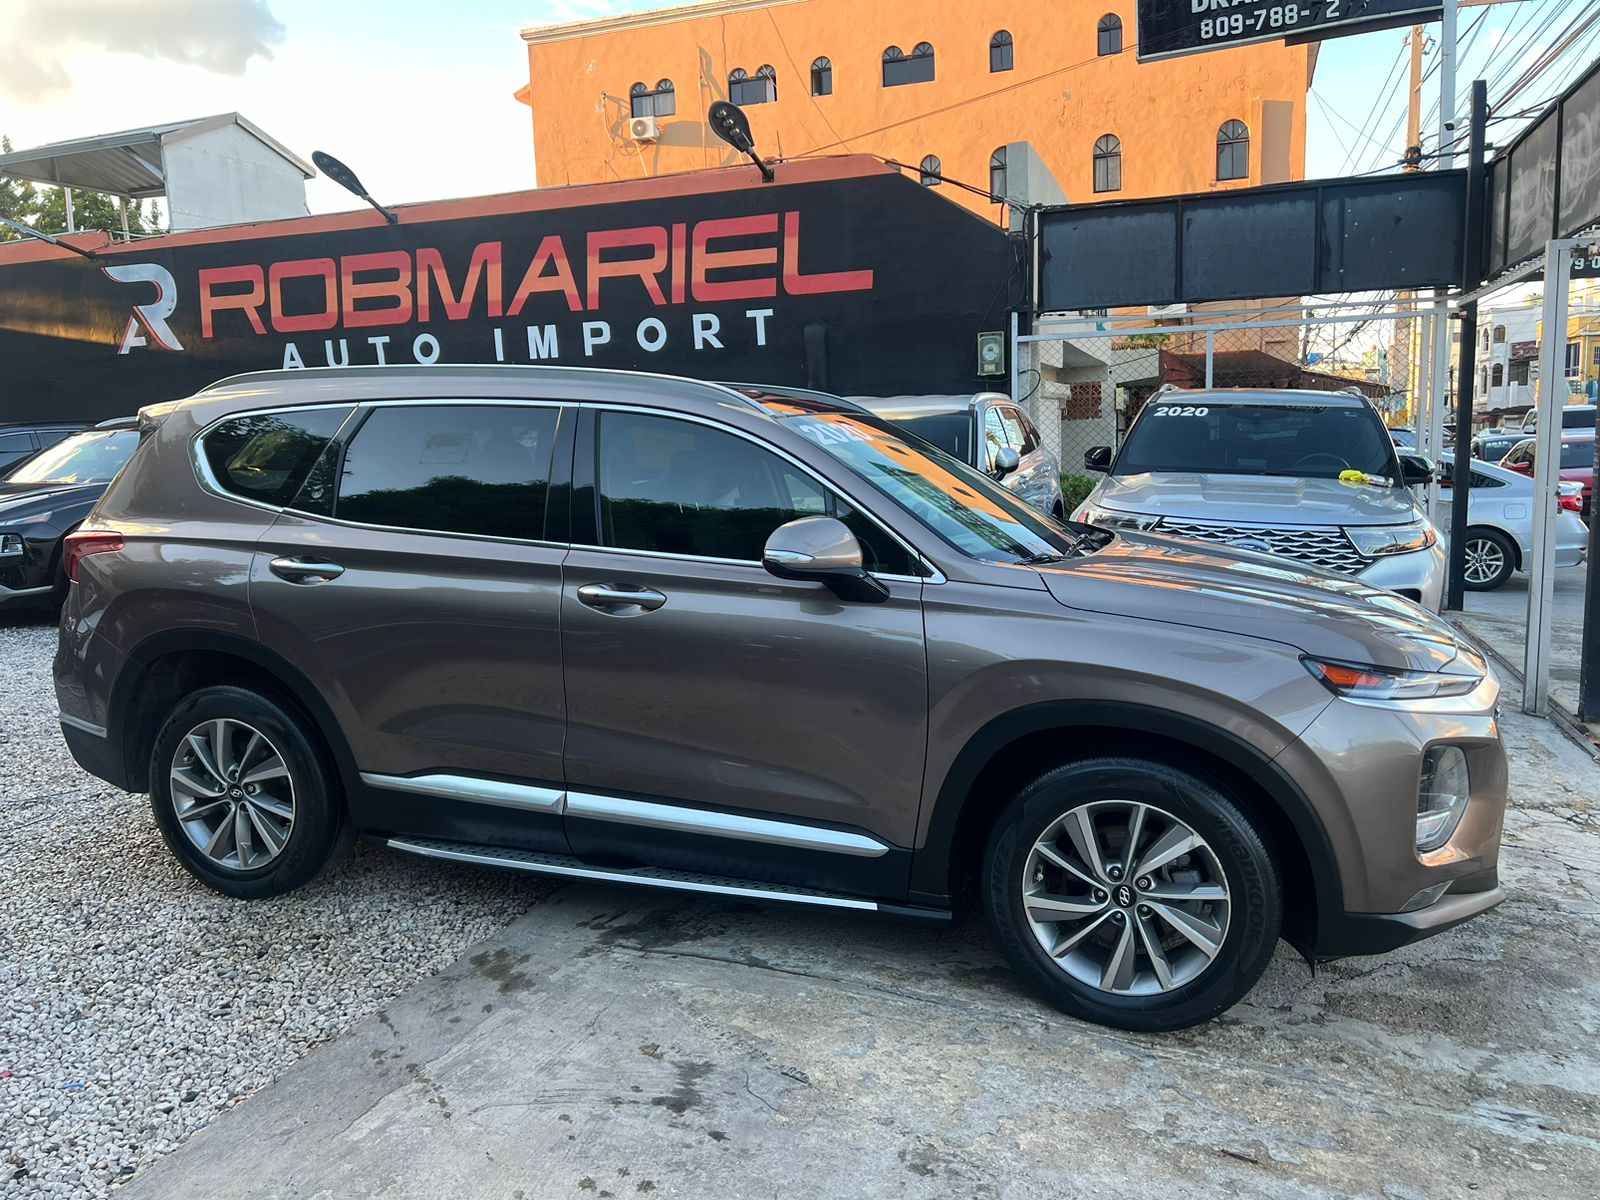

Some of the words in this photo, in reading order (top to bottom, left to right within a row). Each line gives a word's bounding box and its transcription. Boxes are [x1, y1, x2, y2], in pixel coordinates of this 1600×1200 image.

[199, 211, 873, 338] ROBMARIEL
[283, 333, 441, 369] AUTO
[494, 308, 774, 362] IMPORT
[1153, 406, 1209, 417] 2020
